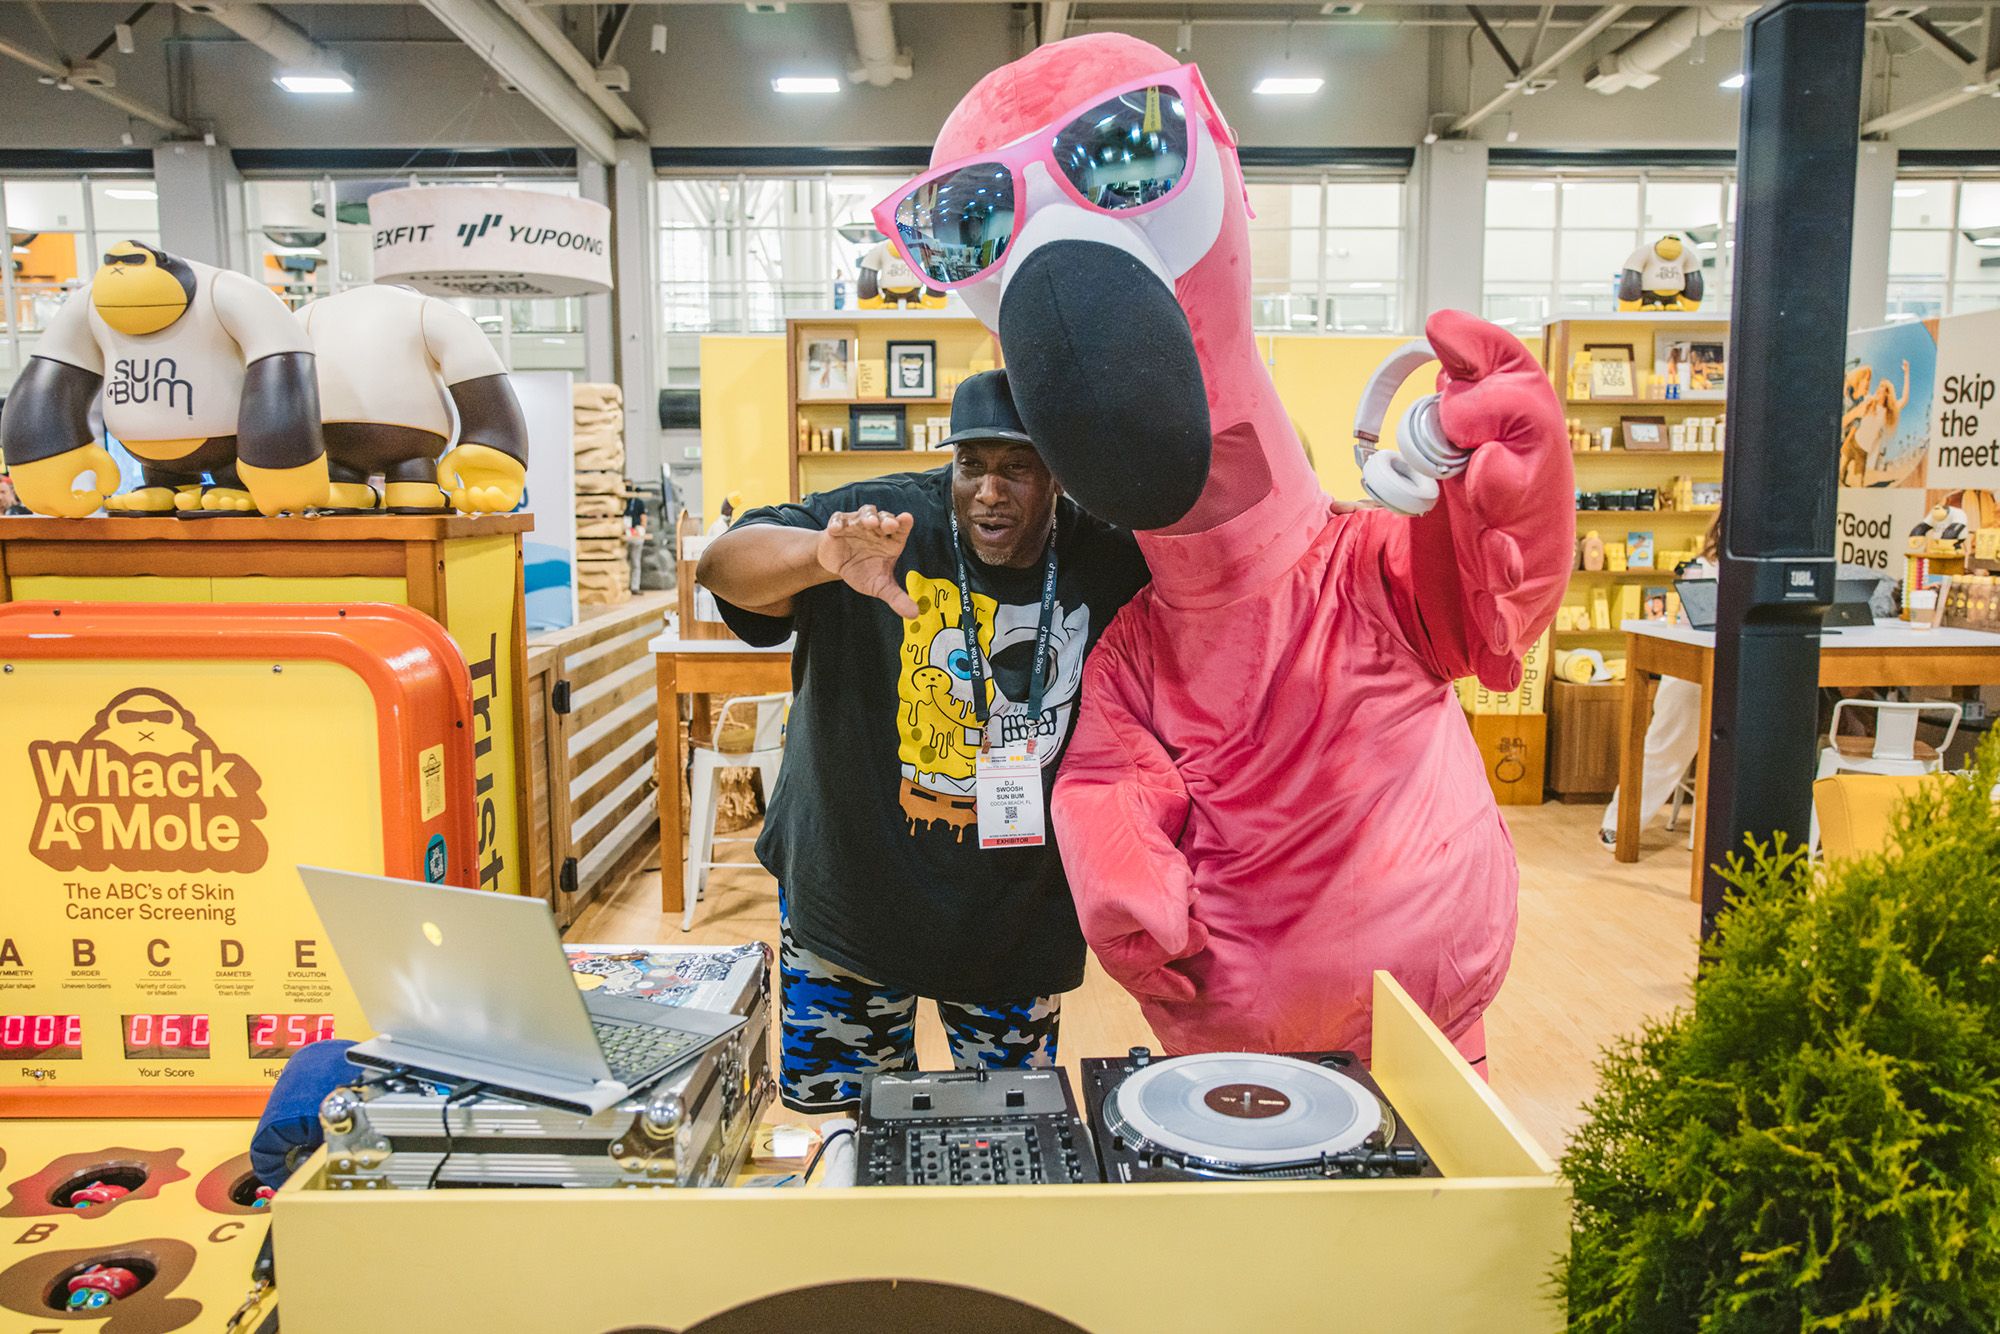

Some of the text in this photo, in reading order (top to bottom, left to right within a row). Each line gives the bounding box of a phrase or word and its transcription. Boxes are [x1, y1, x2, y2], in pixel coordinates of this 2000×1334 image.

[509, 226, 603, 255] YUPOONG
[1943, 373, 1995, 409] Skip
[1941, 409, 1979, 438] the
[1938, 439, 2000, 468] meet
[1843, 513, 1892, 539] Good
[1841, 541, 1888, 569] Days
[961, 581, 971, 603] TikTok
[1044, 570, 1057, 610] TikTok Shop
[1790, 570, 1815, 586] JBL
[968, 628, 979, 671] TikTok Shop
[1035, 632, 1048, 674] TikTok Shop
[1521, 669, 1538, 706] Bum
[37, 748, 238, 798] Whack
[38, 803, 240, 851] A Mole
[996, 837, 1029, 845] EXHIBITOR
[63, 883, 235, 900] The ABC's of Skin
[66, 903, 237, 926] Cancer Screening
[0, 938, 24, 967] A
[72, 938, 96, 967] B
[147, 938, 171, 968] C
[220, 939, 245, 968] D
[295, 940, 317, 968] E
[138, 1067, 195, 1078] Your Score
[13, 1223, 60, 1244] B
[207, 1222, 245, 1243] C
